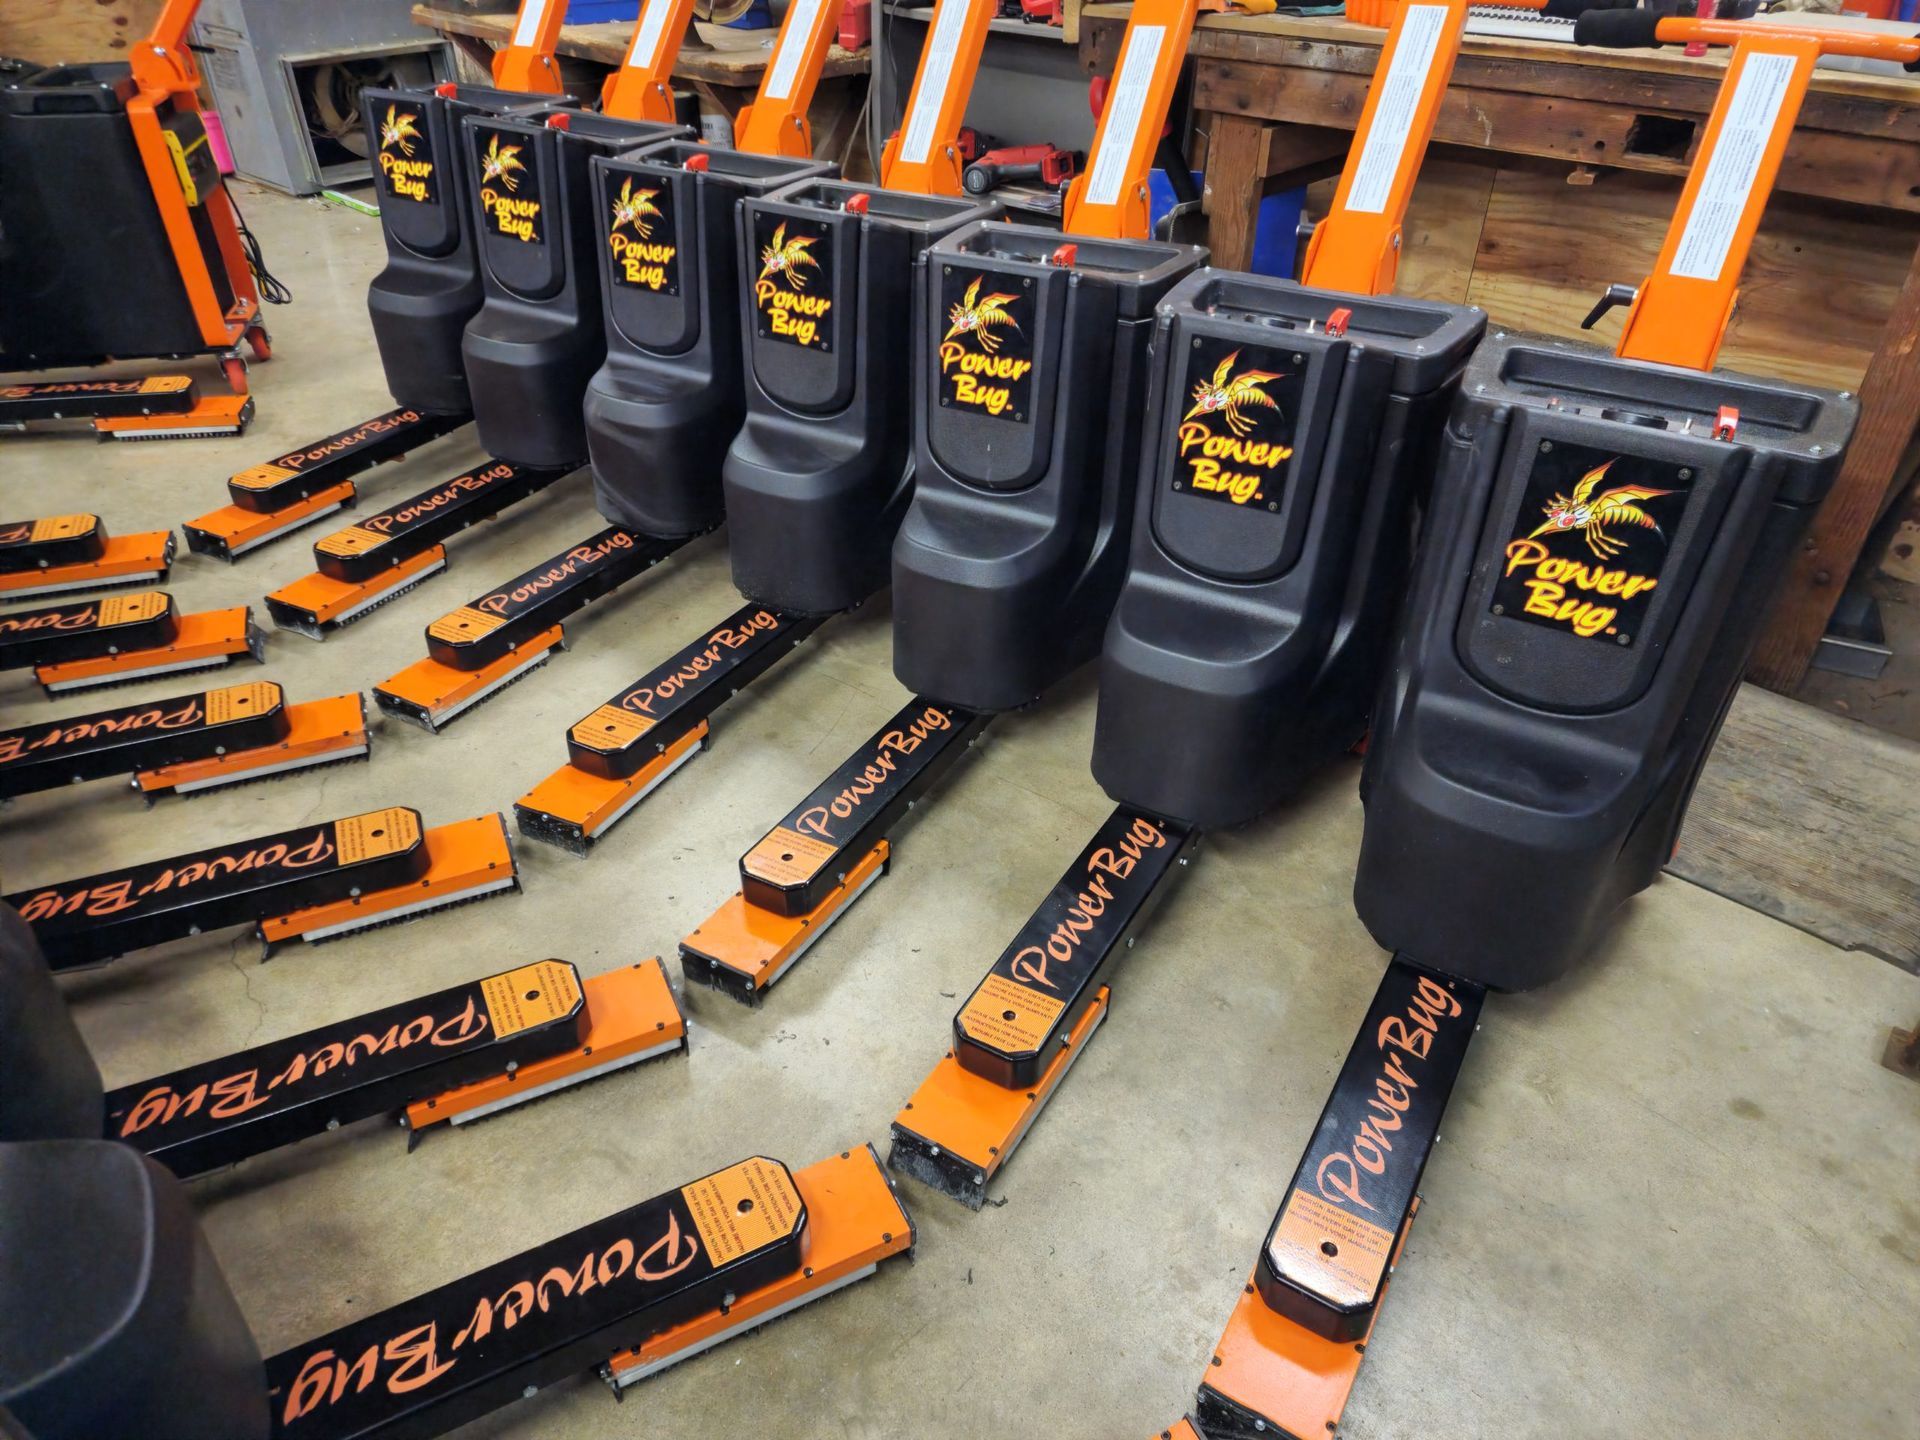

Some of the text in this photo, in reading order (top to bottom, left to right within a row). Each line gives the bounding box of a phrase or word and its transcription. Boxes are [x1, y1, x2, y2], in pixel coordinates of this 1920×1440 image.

[379, 152, 433, 178] Power
[480, 188, 540, 219] Power
[609, 232, 676, 265] Power
[755, 280, 832, 318] Power
[940, 342, 1032, 381] Power
[1178, 422, 1294, 469] Power
[1505, 538, 1658, 600] Power
